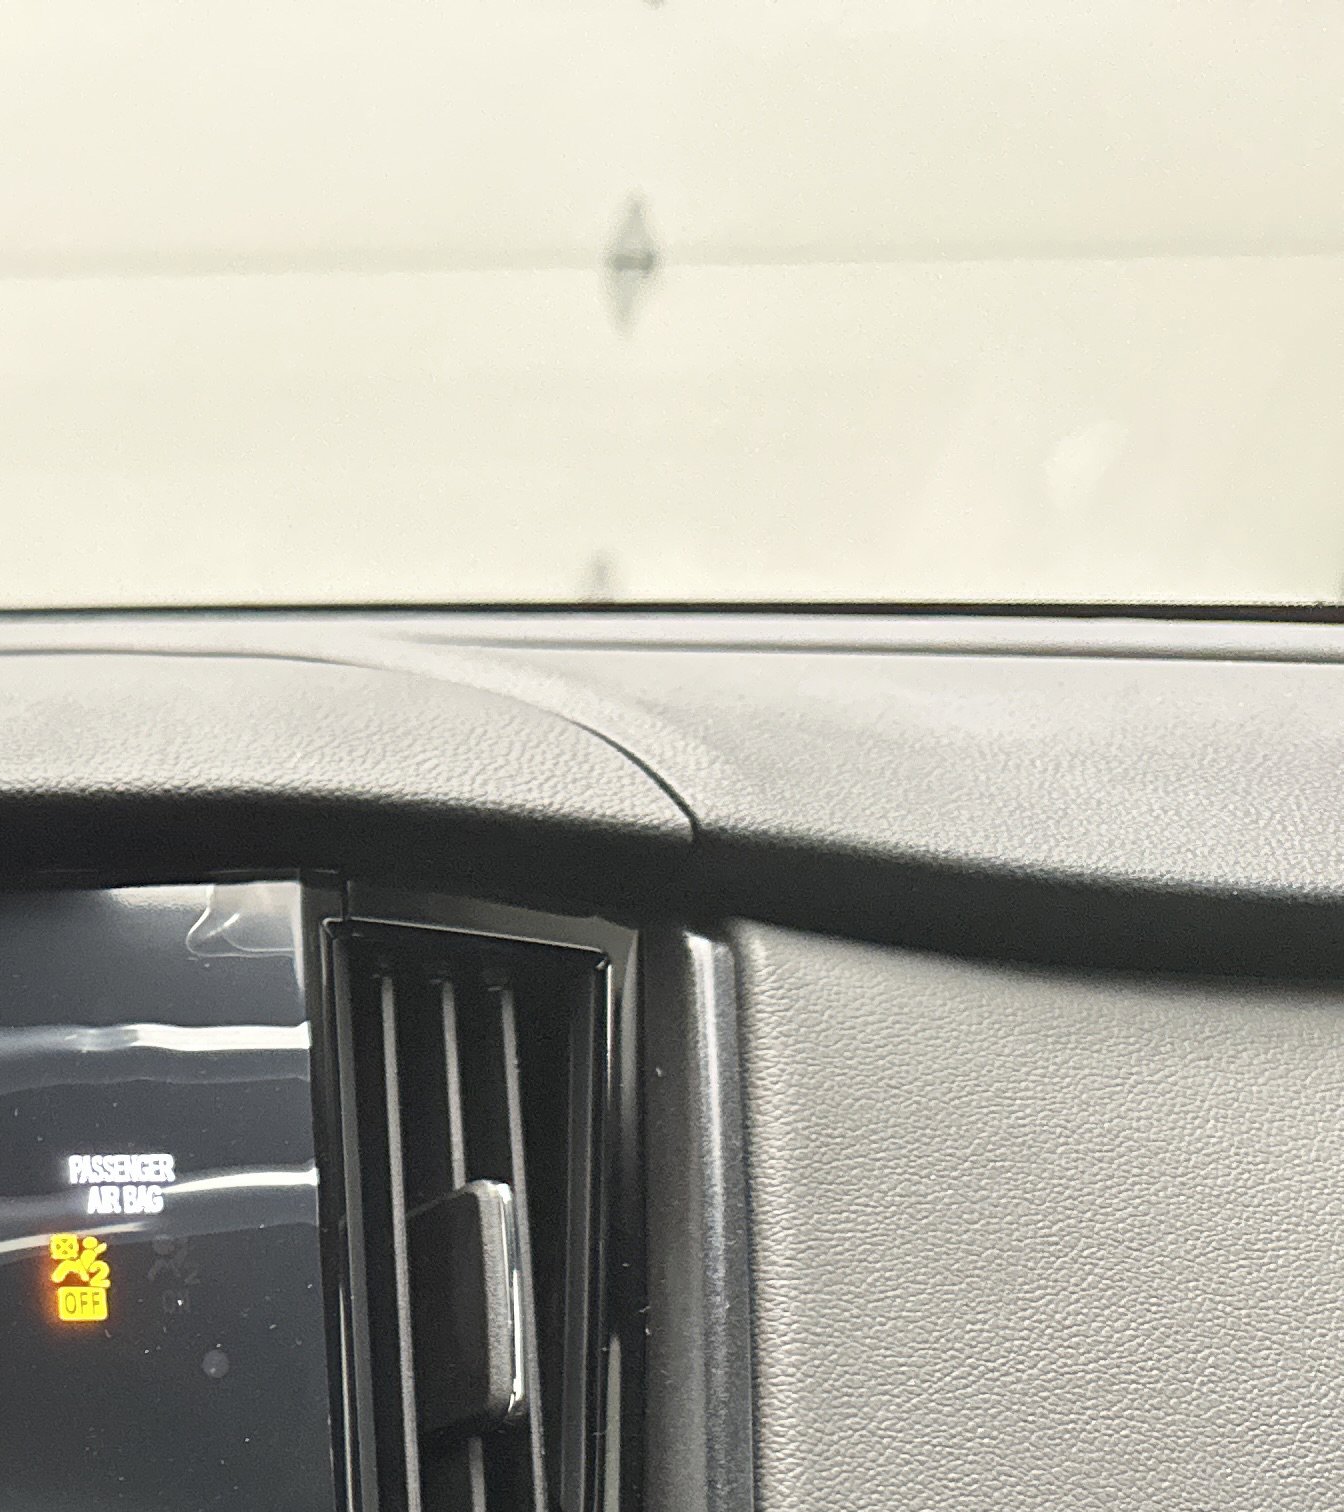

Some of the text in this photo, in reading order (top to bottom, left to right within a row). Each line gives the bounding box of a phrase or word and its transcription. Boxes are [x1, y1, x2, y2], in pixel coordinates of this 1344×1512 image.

[68, 1153, 175, 1184] PASSENGER
[87, 1184, 164, 1214] AIR BAG
[63, 1291, 102, 1315] OFF
